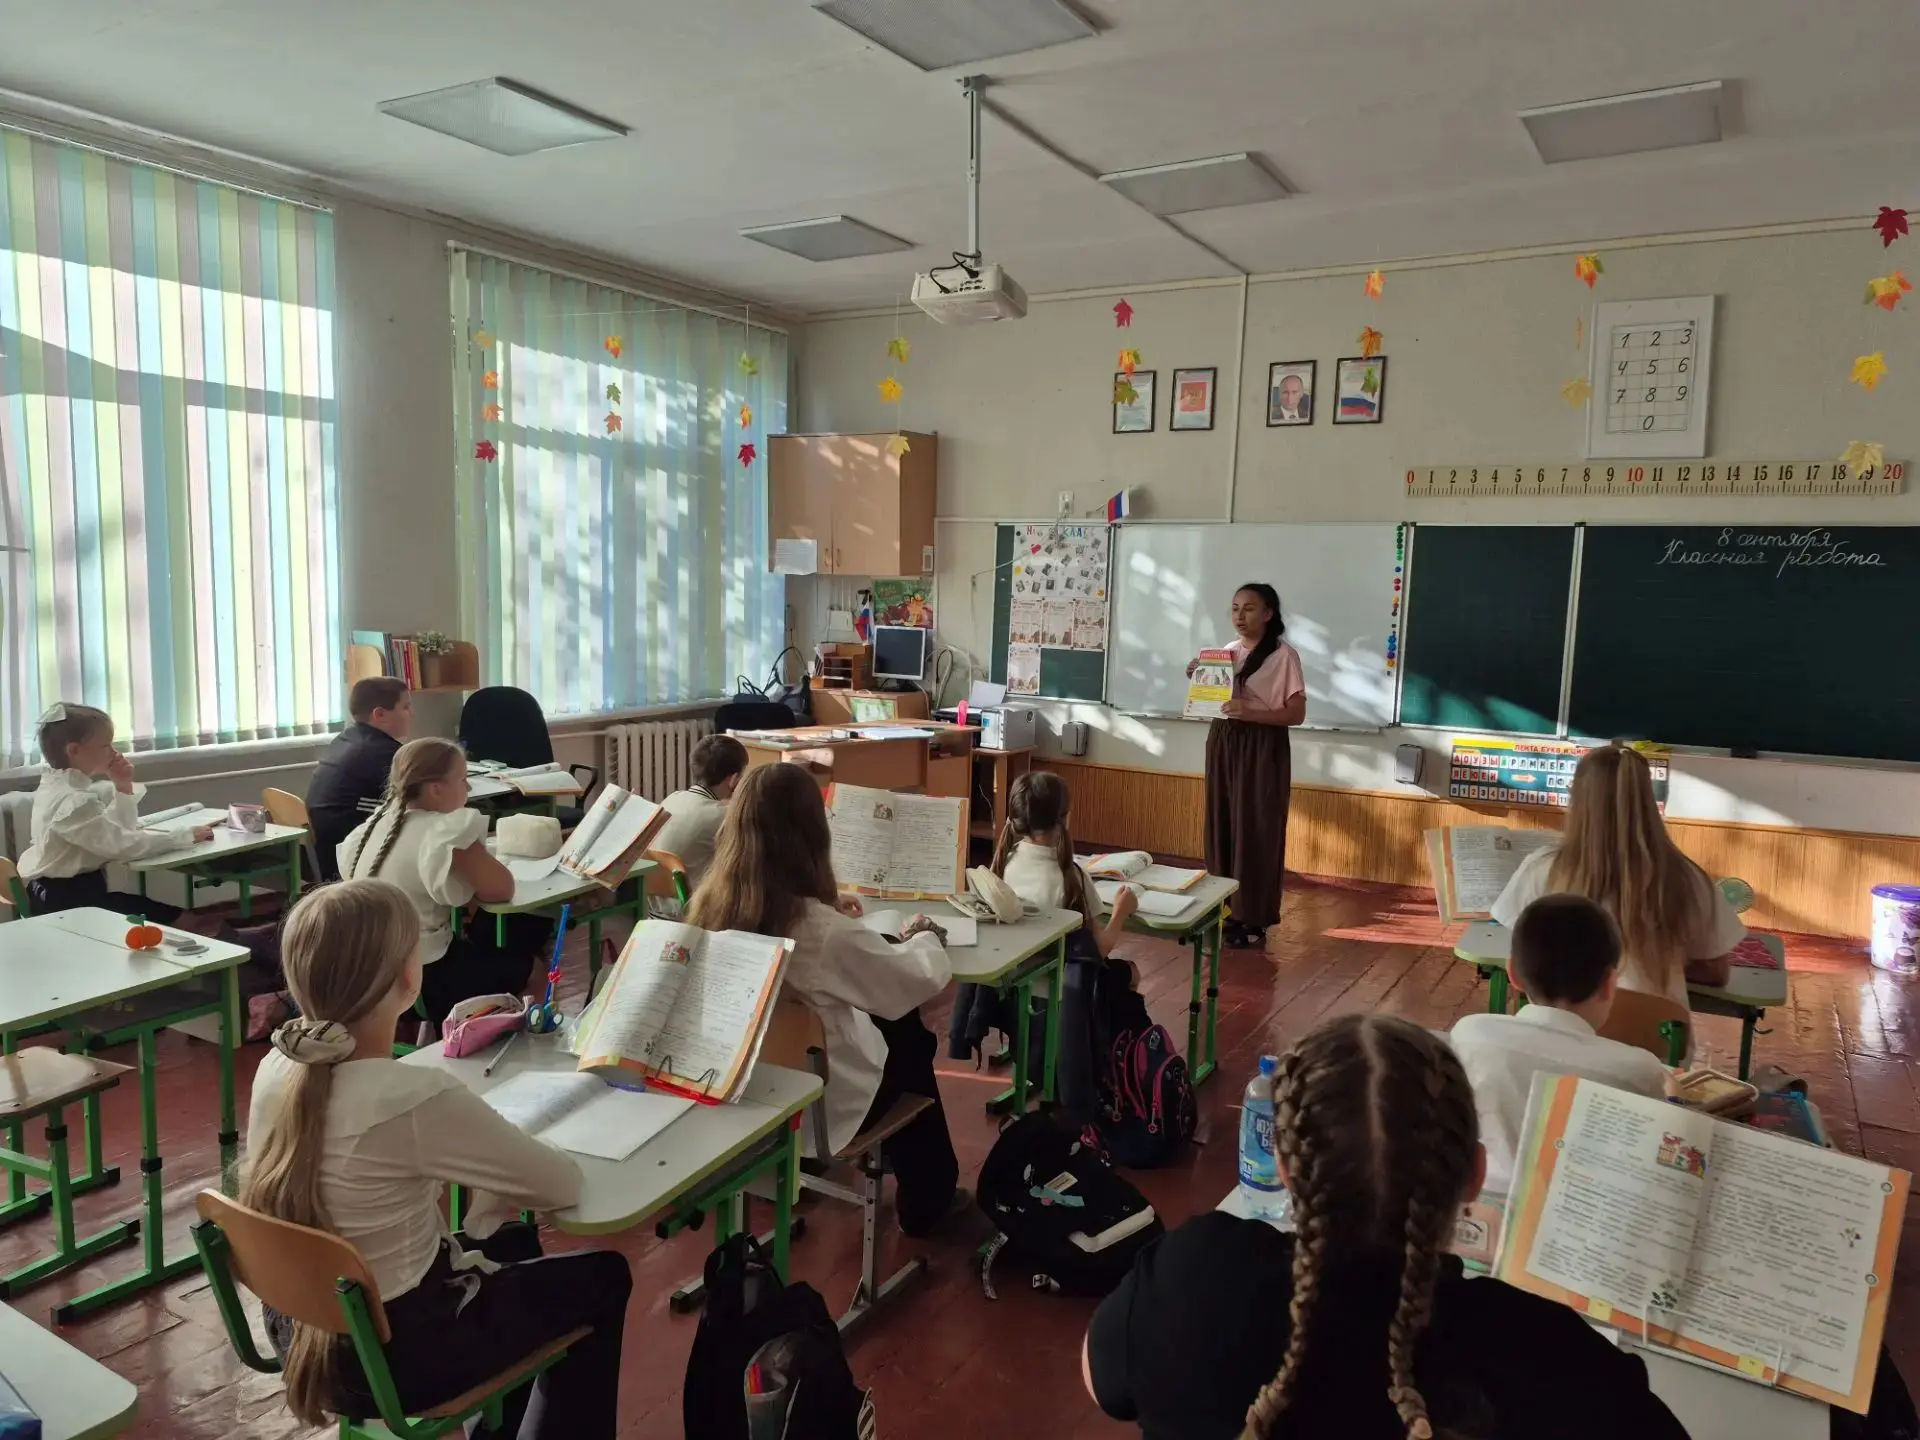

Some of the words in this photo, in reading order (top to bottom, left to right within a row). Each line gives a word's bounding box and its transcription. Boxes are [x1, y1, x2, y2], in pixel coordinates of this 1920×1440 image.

[1620, 333, 1631, 348] 1
[1649, 331, 1661, 347] 2
[1680, 329, 1692, 344] 3
[1618, 361, 1628, 376] 4
[1647, 359, 1659, 375] 5
[1678, 357, 1690, 372] 6
[1616, 389, 1626, 403] 7
[1645, 388, 1657, 403] 8
[1676, 386, 1688, 401] 9
[1642, 416, 1654, 430] 0
[1407, 470, 1415, 484] 0
[1428, 471, 1434, 484] 1
[1450, 470, 1457, 484] 2
[1470, 469, 1478, 483] 3
[1491, 469, 1498, 483] 4
[1514, 469, 1522, 482] 5
[1537, 468, 1545, 482] 6
[1561, 468, 1568, 482] 7
[1583, 468, 1590, 482] 8
[1606, 468, 1614, 482] 9
[1627, 467, 1644, 482] 10
[1652, 467, 1663, 482] 11
[1677, 466, 1690, 481] 12
[1701, 466, 1715, 481] 13
[1726, 465, 1741, 480] 14
[1753, 465, 1768, 480] 15
[1778, 465, 1793, 480] 16
[1806, 464, 1820, 480] 17
[1832, 464, 1846, 480] 18
[1884, 464, 1902, 480] 20
[1717, 528, 1733, 546] 8
[1737, 528, 1832, 552] сентября
[1656, 538, 1767, 565] Классная
[1776, 540, 1886, 578] работа
[1454, 755, 1461, 763] А
[1472, 756, 1479, 764] У
[1530, 759, 1536, 767] М
